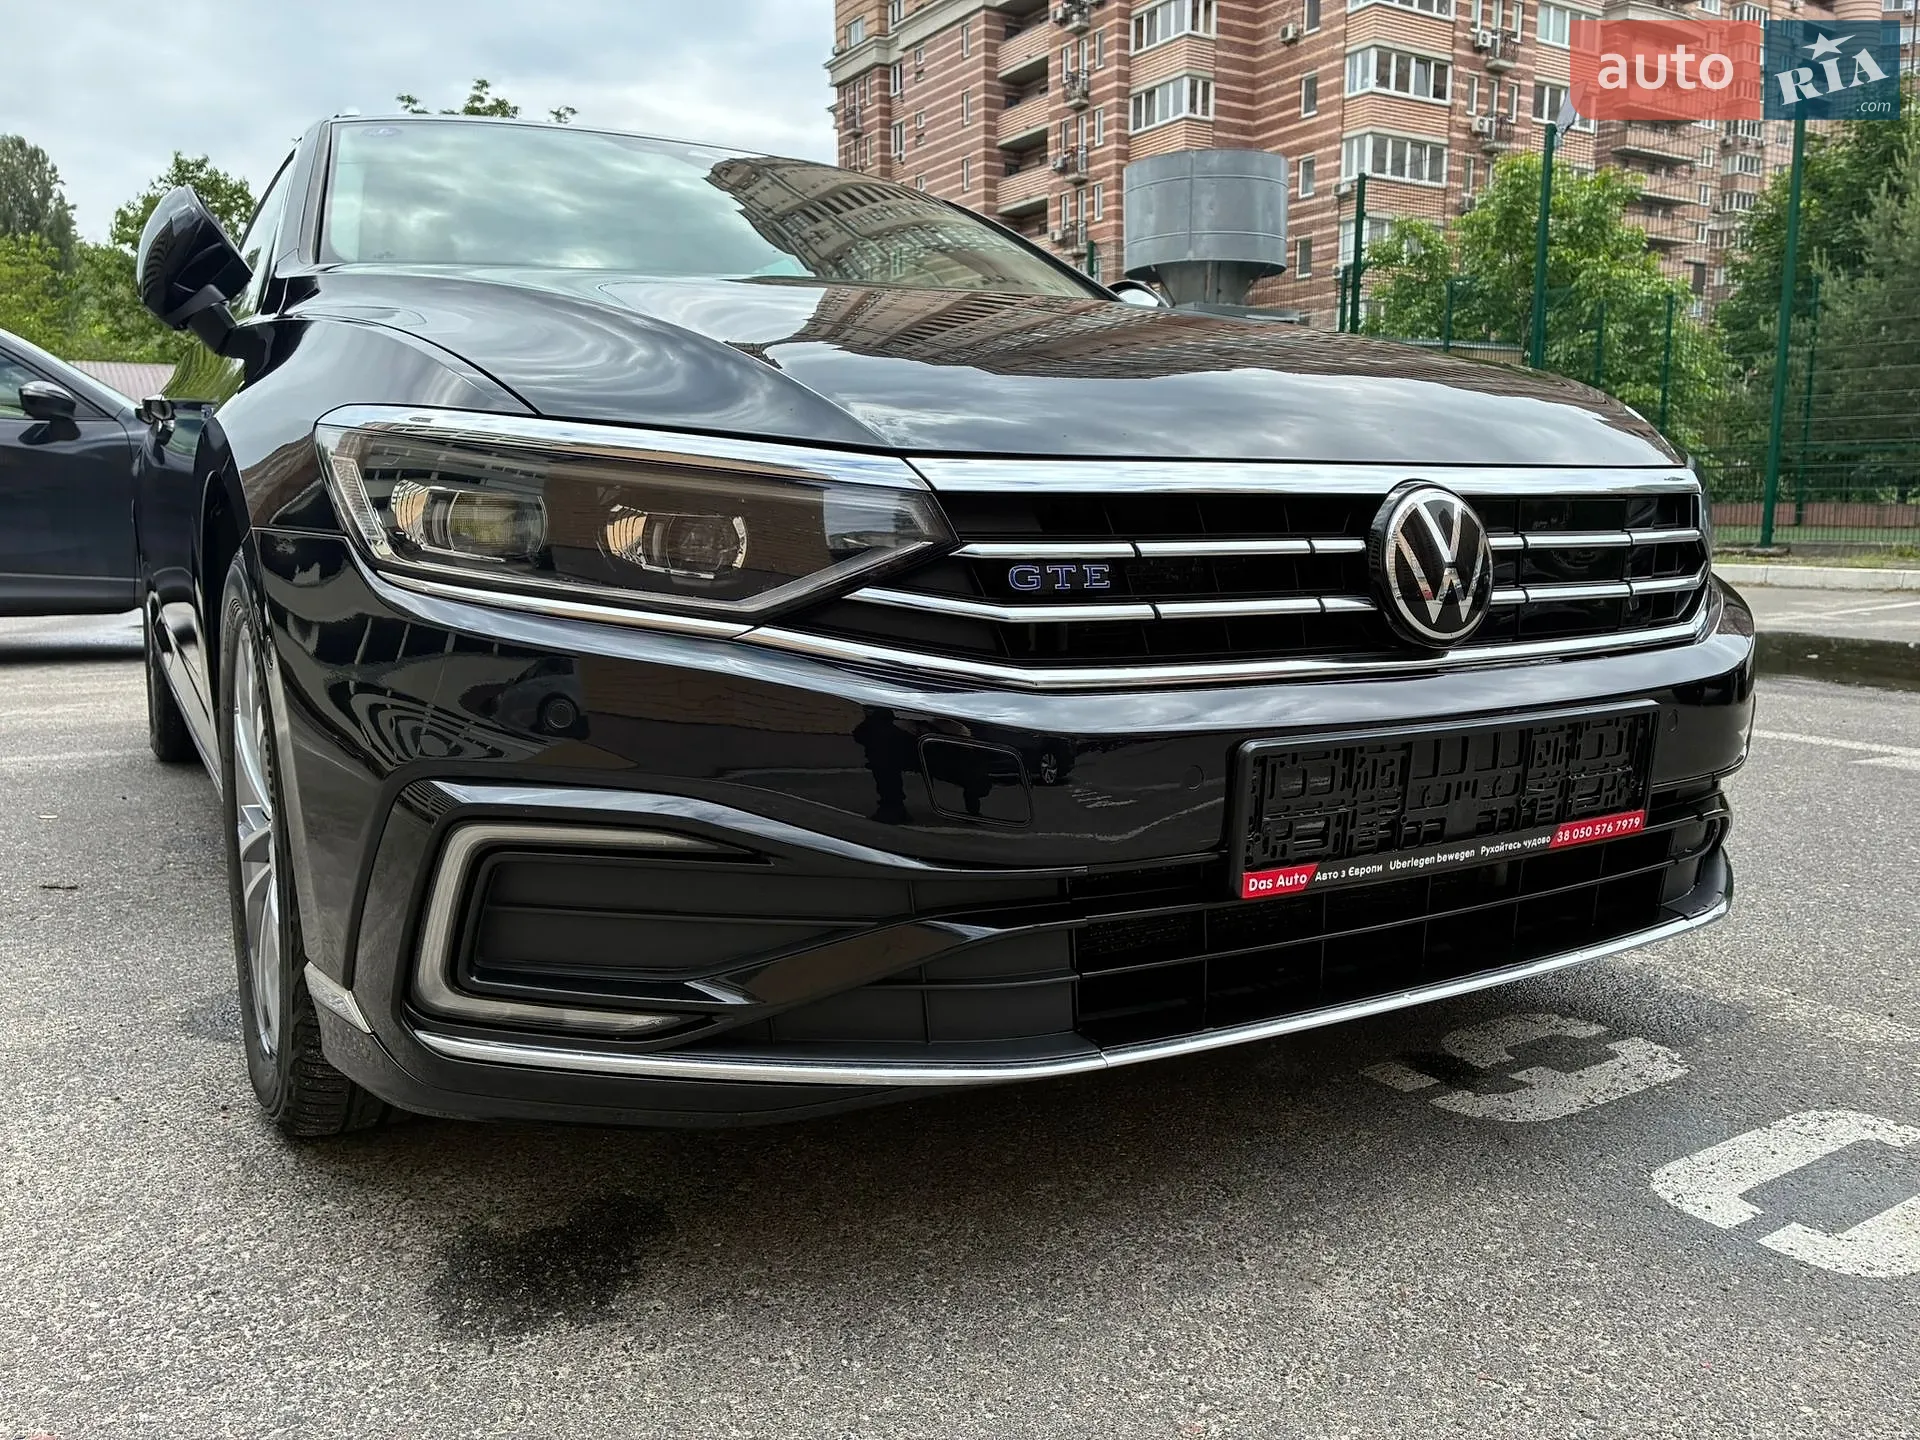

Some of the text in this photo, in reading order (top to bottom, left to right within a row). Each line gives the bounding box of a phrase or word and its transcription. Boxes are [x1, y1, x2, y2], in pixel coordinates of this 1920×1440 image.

[1008, 564, 1111, 590] GTE
[1557, 817, 1640, 842] 38 050 576 7979
[1481, 835, 1551, 856] Рухайтесь чудово
[1437, 849, 1475, 863] bewegen
[1248, 873, 1308, 892] Das Auto
[1315, 864, 1383, 882] Авто з Європи
